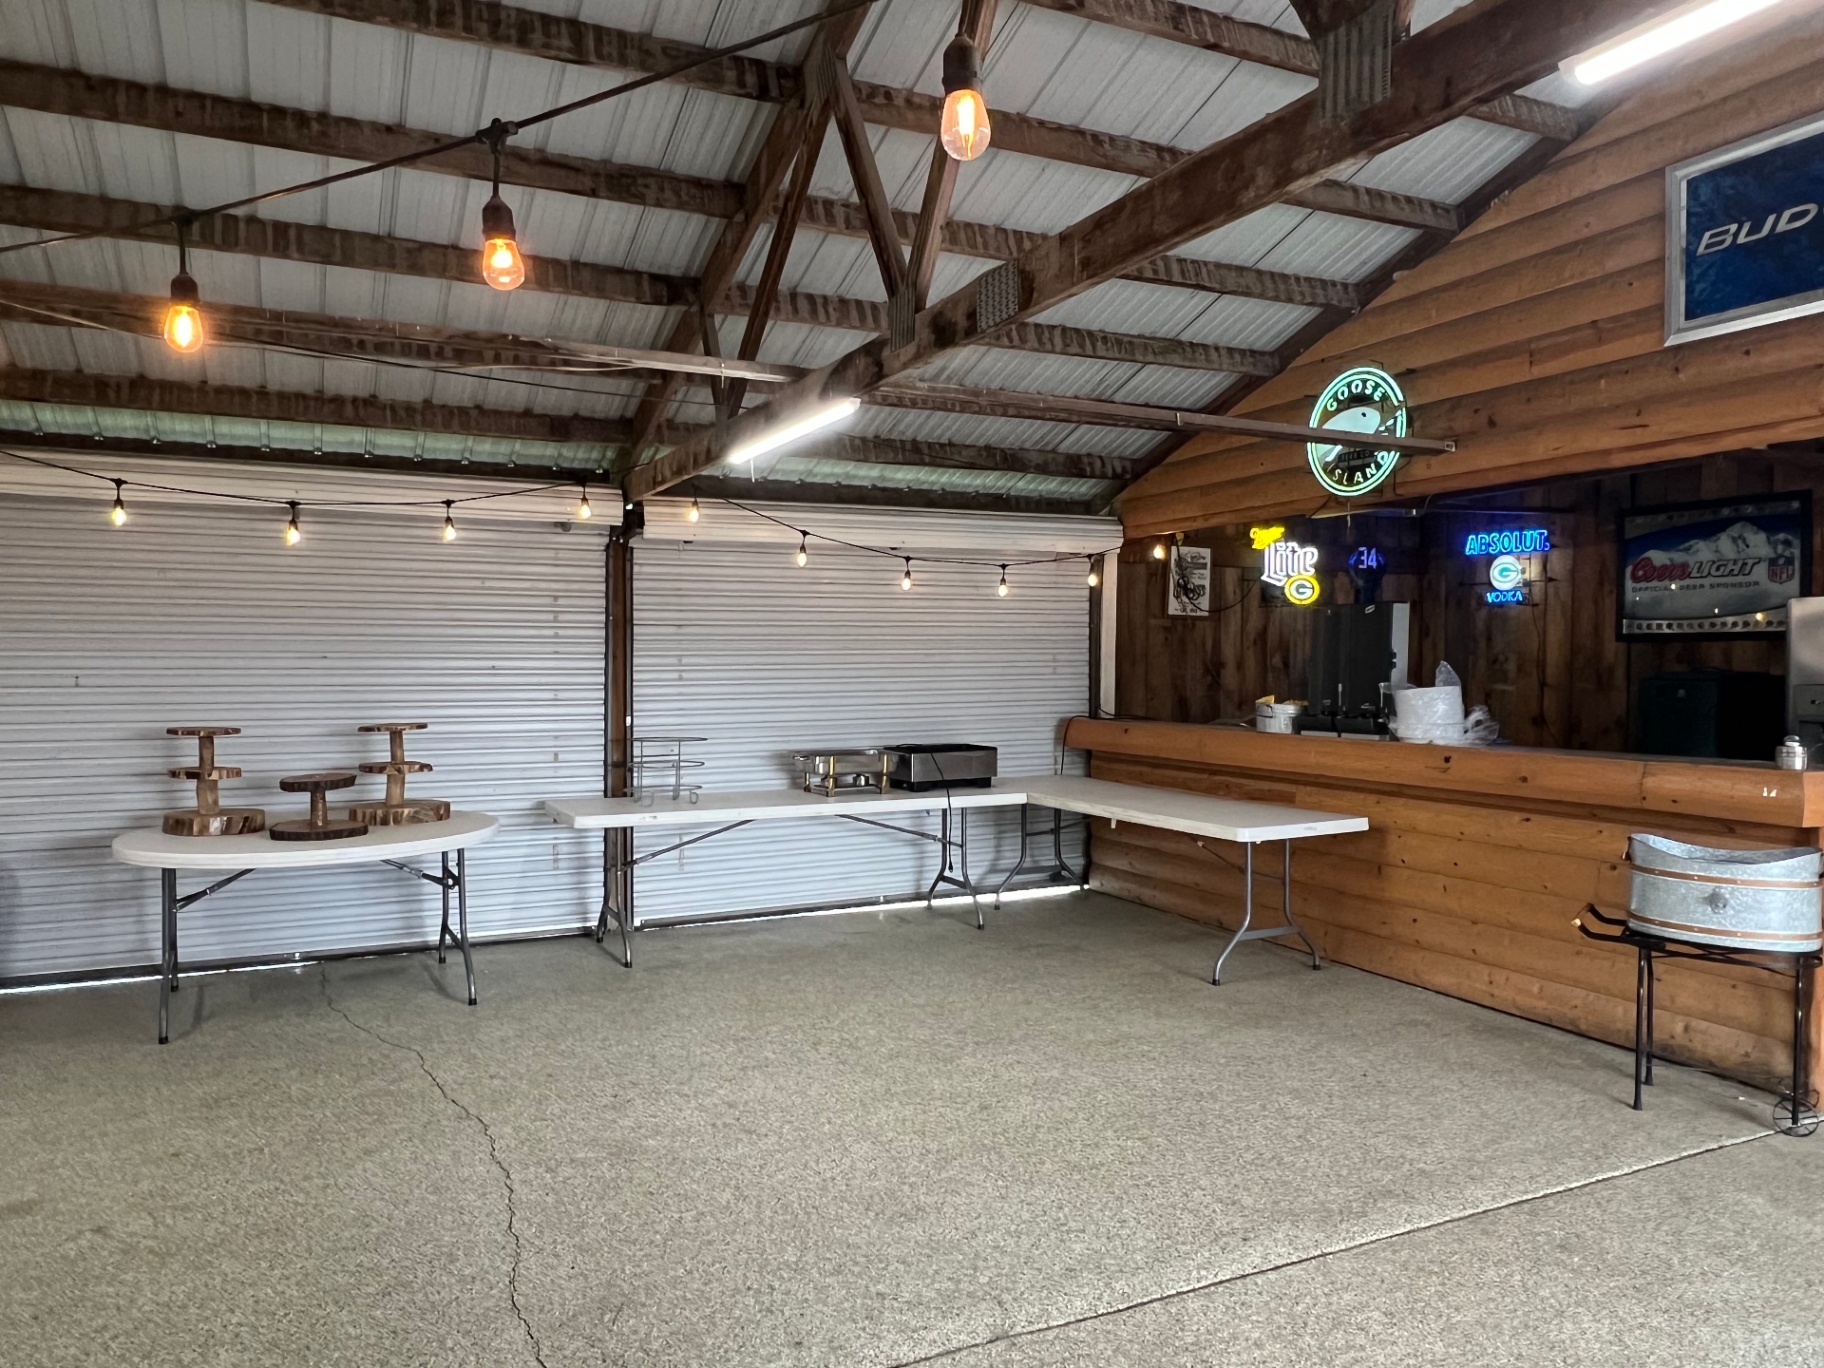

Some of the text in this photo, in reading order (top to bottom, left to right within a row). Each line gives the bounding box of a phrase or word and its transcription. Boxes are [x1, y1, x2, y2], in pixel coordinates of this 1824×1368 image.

[1696, 203, 1819, 256] BUD
[1326, 379, 1386, 411] GOOSE
[1327, 450, 1389, 485] ISLAND
[1261, 539, 1319, 587] Lite
[1358, 547, 1377, 569] 34
[1630, 556, 1762, 584] Coors LIGHT
[1768, 566, 1794, 582] NFL
[1486, 591, 1524, 603] VODKA
